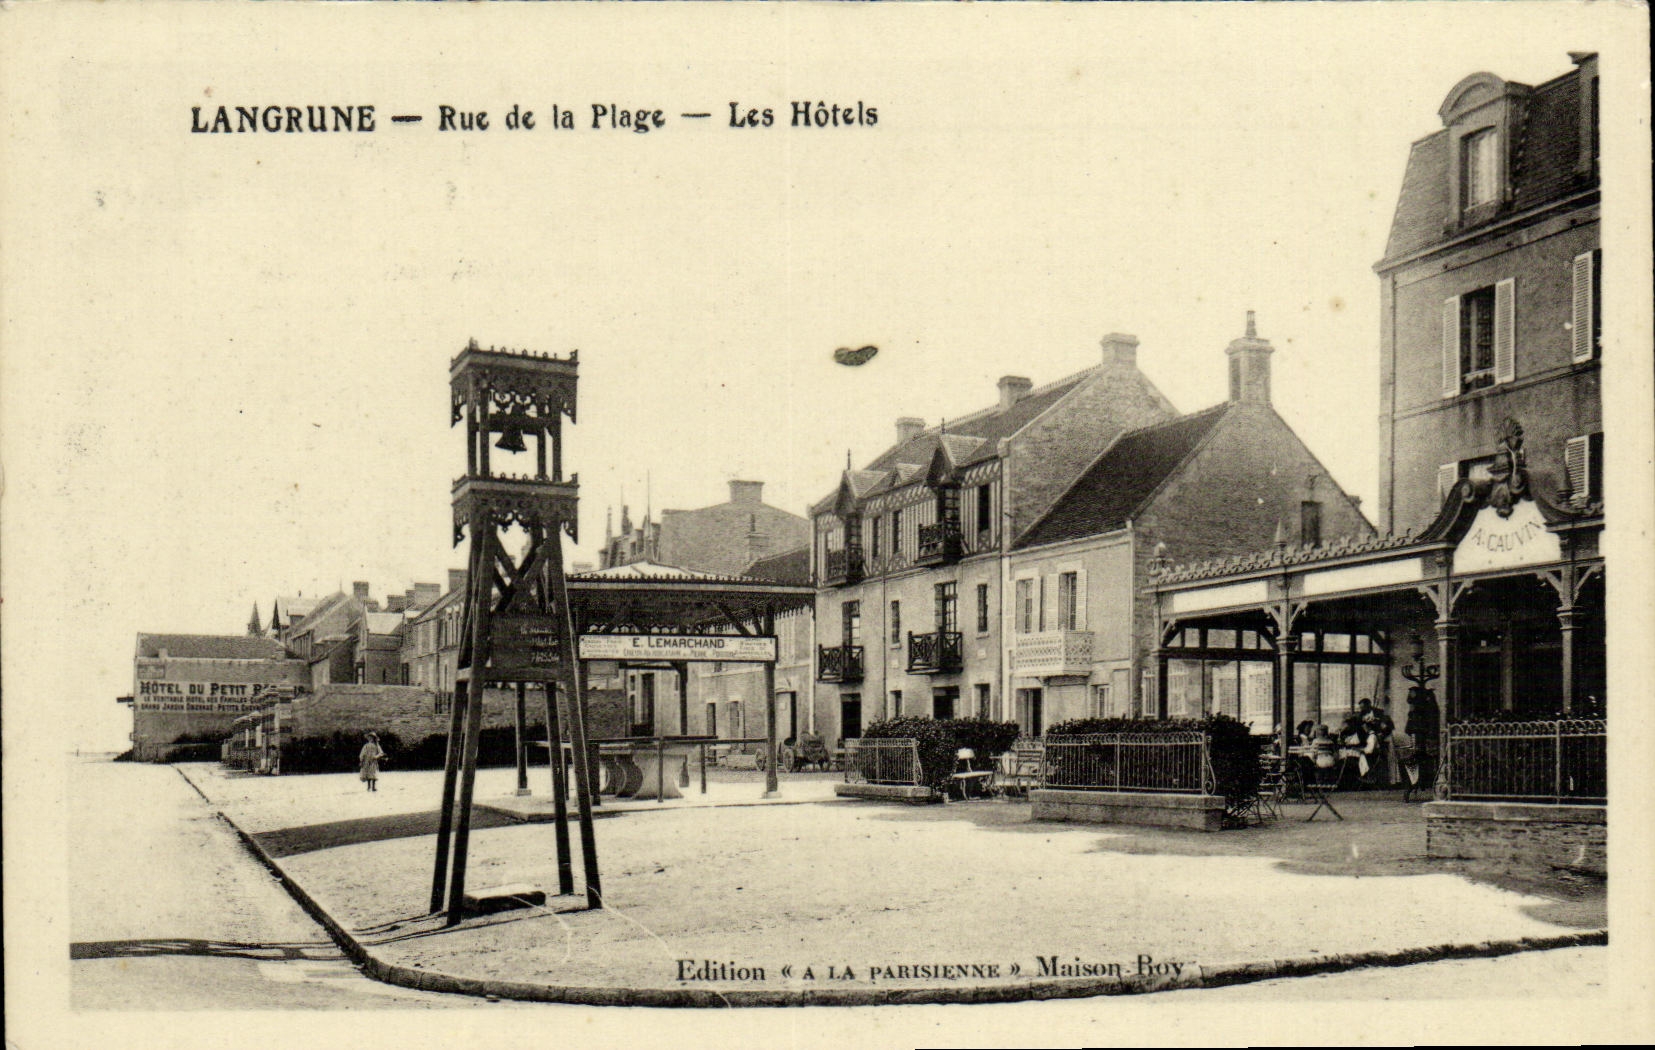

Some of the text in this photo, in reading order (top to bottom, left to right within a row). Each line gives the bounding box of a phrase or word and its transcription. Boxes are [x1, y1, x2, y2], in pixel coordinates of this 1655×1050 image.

[647, 636, 725, 649] LEMARCHAND
[189, 683, 204, 695] DU
[210, 683, 247, 696] PETIT
